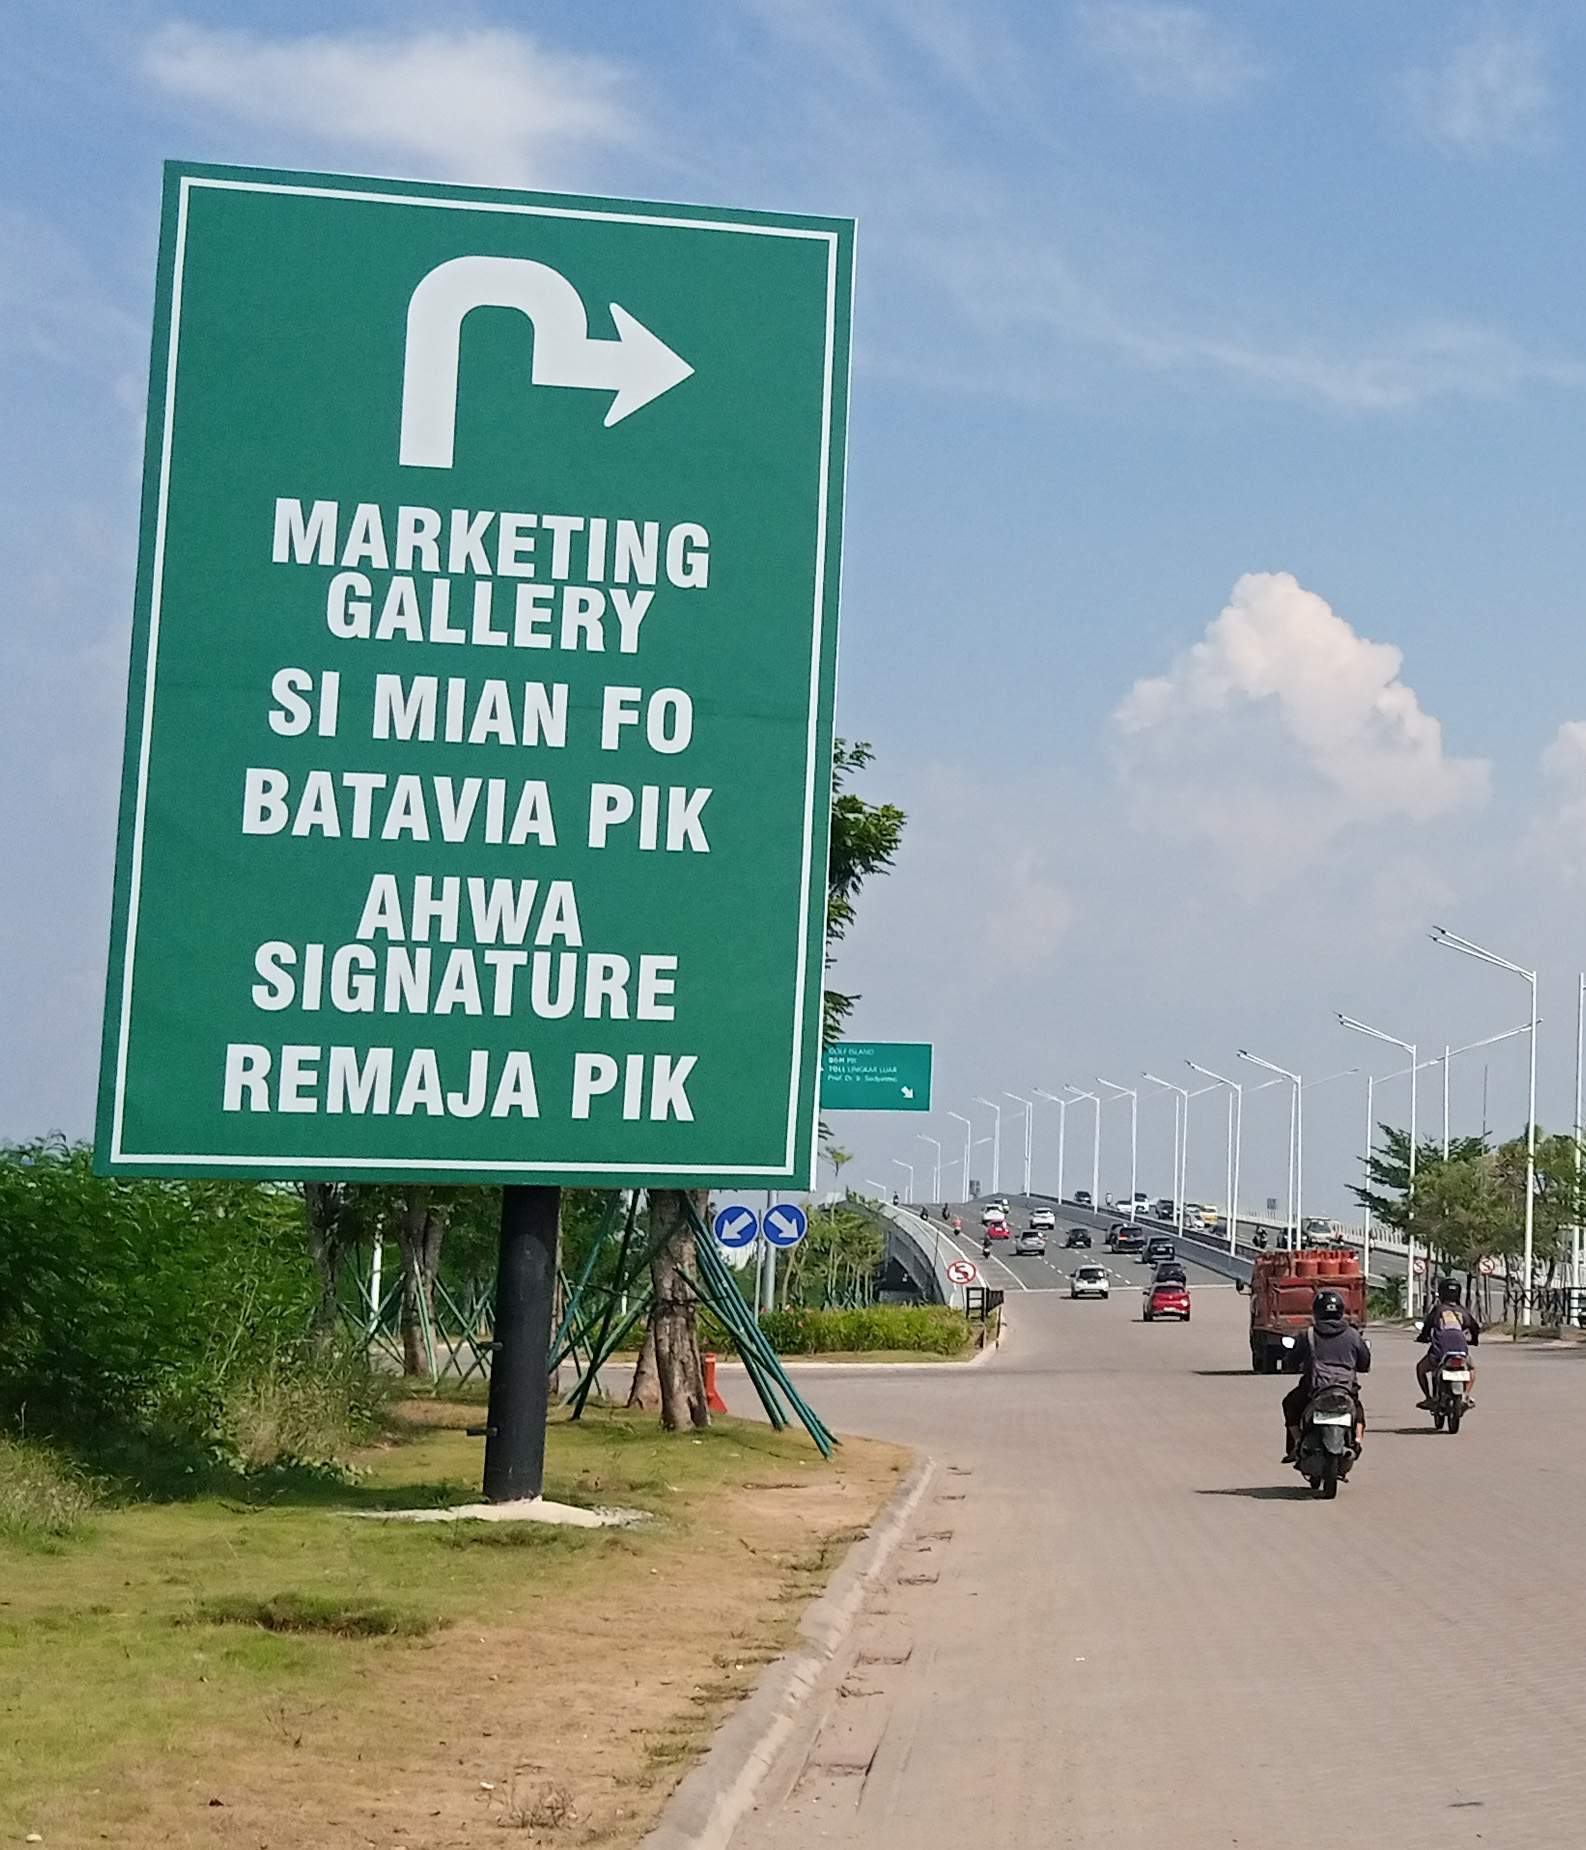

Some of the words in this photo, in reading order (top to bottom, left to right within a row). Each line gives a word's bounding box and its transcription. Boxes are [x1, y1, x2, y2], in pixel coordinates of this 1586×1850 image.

[272, 497, 710, 588] MARKETING
[326, 571, 655, 654] GALLERY
[268, 667, 340, 737] SI
[372, 673, 569, 748] MIAN
[601, 685, 693, 754] FO
[242, 767, 557, 846] BATAVIA
[588, 783, 713, 853] PIK
[355, 873, 583, 947] AHWA
[251, 941, 678, 1021] SIGNATURE
[223, 1043, 540, 1118] REMAJA
[571, 1052, 698, 1121] PIK
